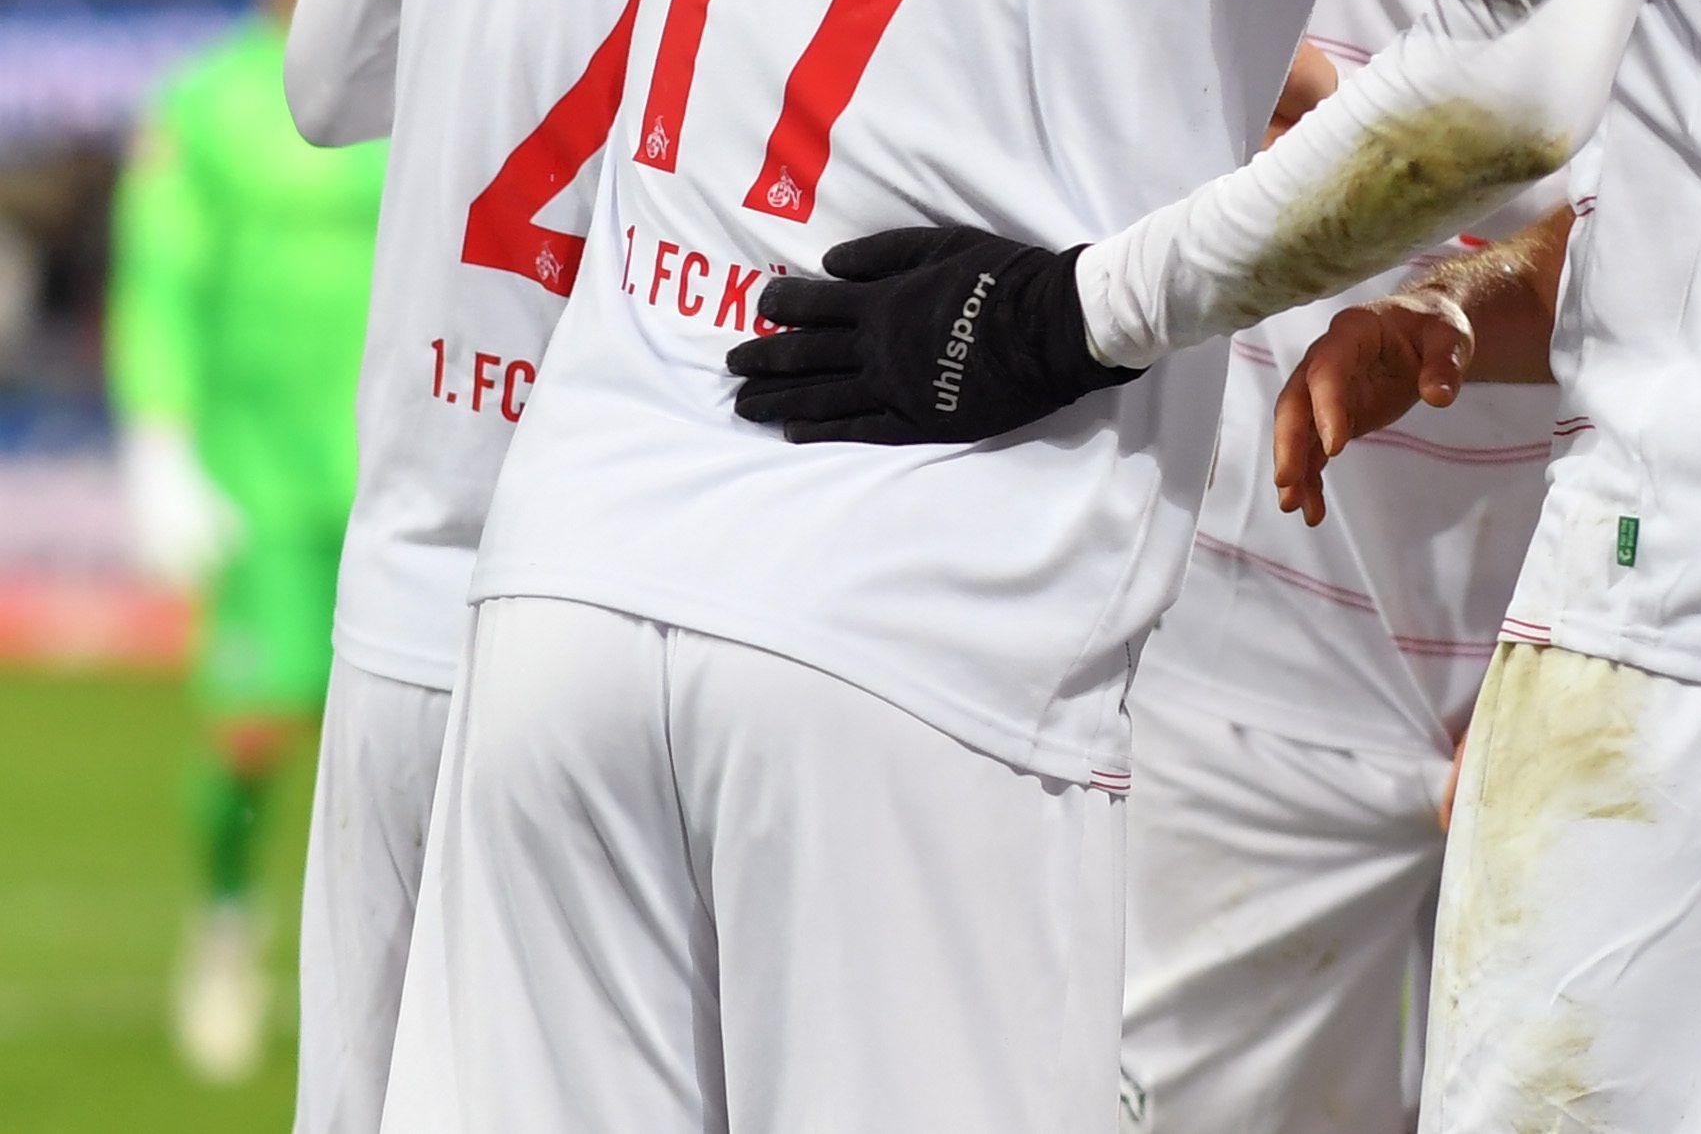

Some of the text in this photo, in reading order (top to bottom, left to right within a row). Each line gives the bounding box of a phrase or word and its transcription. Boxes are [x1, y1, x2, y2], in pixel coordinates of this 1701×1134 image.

[648, 240, 710, 317] FC
[431, 338, 537, 424] 1. FC
[933, 272, 997, 412] uhlsport
